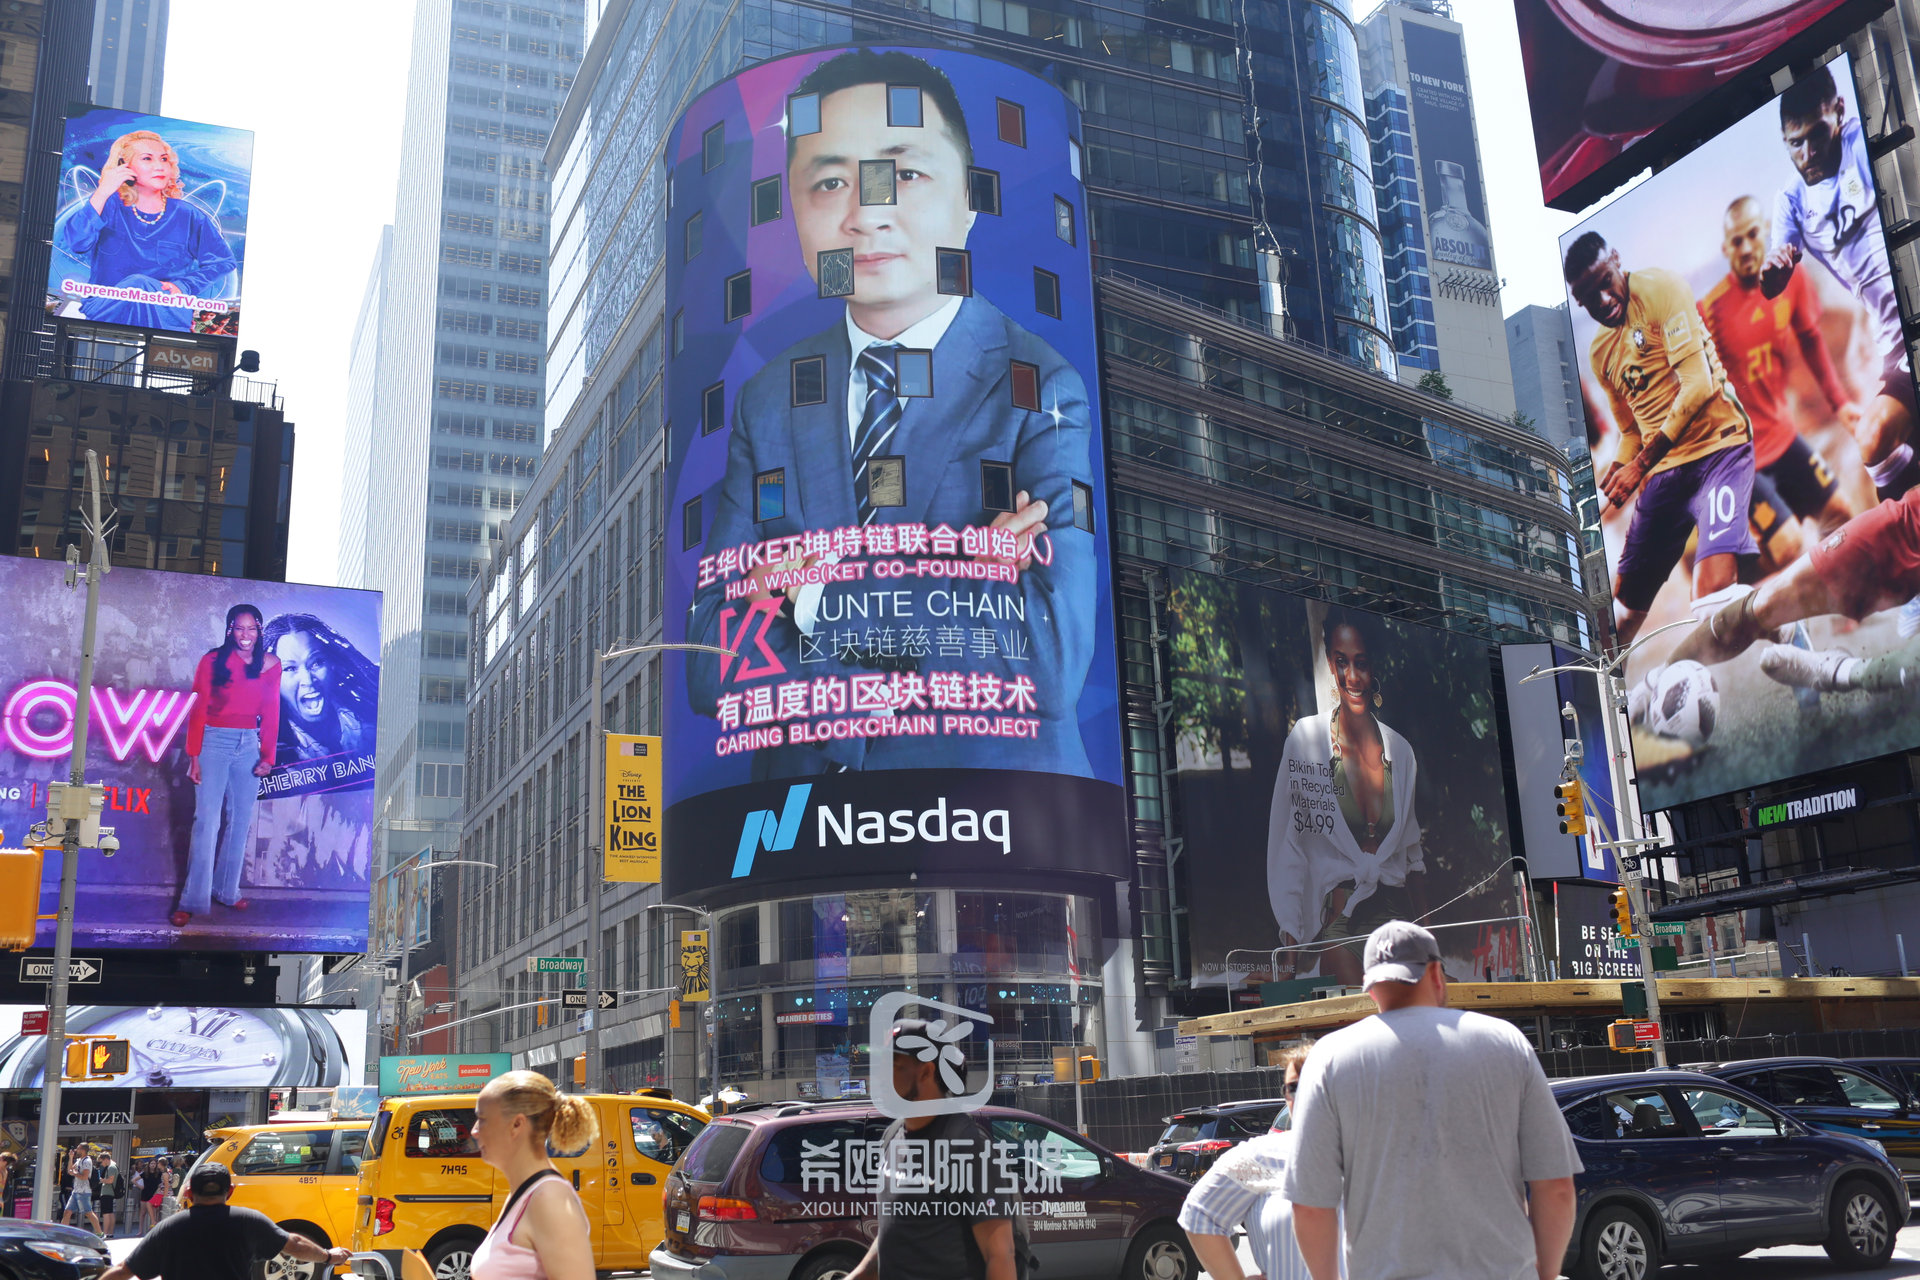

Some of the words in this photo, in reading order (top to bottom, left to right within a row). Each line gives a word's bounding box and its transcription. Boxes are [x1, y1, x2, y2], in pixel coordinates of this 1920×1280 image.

[1410, 72, 1421, 83] TO
[1422, 75, 1440, 87] NEW
[63, 280, 227, 312] SupremeMasterTV.com
[153, 350, 213, 370] Absen
[1707, 485, 1736, 526] 10
[698, 524, 1053, 588] 王华(KET坤特链联合创始人)
[725, 580, 759, 600] HUA
[765, 562, 868, 590] WANG(KET
[927, 590, 1025, 622] CHAIN
[799, 624, 1031, 664] 区块链慈善事业
[716, 672, 1037, 731] 有温度的区块链技术
[716, 728, 782, 755] CARING
[790, 716, 936, 743] BLOCKCHAIN
[944, 716, 1040, 738] PROJECT
[333, 755, 377, 779] BAN
[1288, 759, 1315, 776] Bikini
[1316, 763, 1335, 780] Top
[617, 785, 645, 798] THE
[1289, 776, 1299, 790] in
[1301, 778, 1345, 797] Recycled
[612, 800, 651, 823] LION
[1291, 793, 1336, 812] Materials
[818, 797, 1010, 855] Nasdaq
[1294, 809, 1335, 835] $4.99
[610, 824, 657, 851] KING
[1629, 871, 1641, 879] LANE
[1581, 925, 1596, 940] BE
[1655, 924, 1684, 935] Broadway
[1472, 924, 1517, 979] H&M
[1585, 944, 1601, 957] ON
[1606, 945, 1628, 959] THE
[33, 965, 54, 975] ONE
[540, 959, 583, 972] Broadway
[1202, 962, 1219, 971] NOW
[1228, 963, 1254, 972] STORES
[1256, 963, 1270, 972] AND
[1274, 964, 1296, 973] NLINE
[1572, 961, 1592, 975] BIG
[1598, 961, 1642, 977] SCREEN
[570, 996, 586, 1004] ONE
[598, 996, 609, 1004] AY
[776, 1014, 807, 1023] BRANDED
[808, 1012, 832, 1021] CITIES
[460, 1067, 489, 1075] seamless
[66, 1111, 133, 1125] CITIZEN
[441, 1165, 468, 1175] 7H95
[1041, 1200, 1086, 1216] Dynamex
